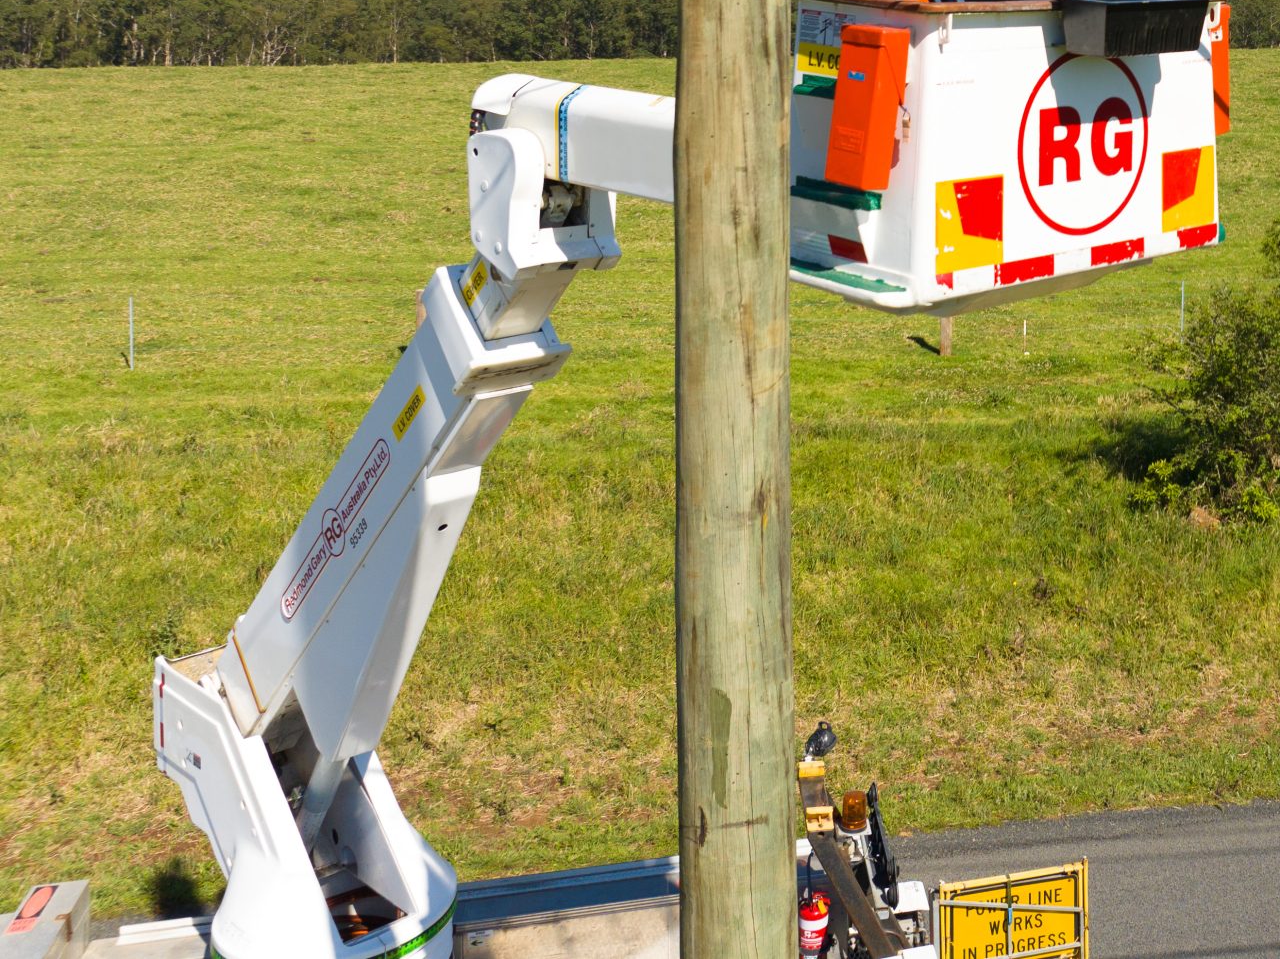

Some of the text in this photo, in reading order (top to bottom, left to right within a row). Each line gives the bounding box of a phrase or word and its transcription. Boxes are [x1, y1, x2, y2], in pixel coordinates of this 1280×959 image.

[1039, 96, 1133, 186] RG
[285, 564, 313, 610] Redmond
[310, 544, 327, 570] Gary
[324, 517, 343, 550] RG
[341, 480, 367, 523] Australia
[1028, 887, 1062, 906] LINE
